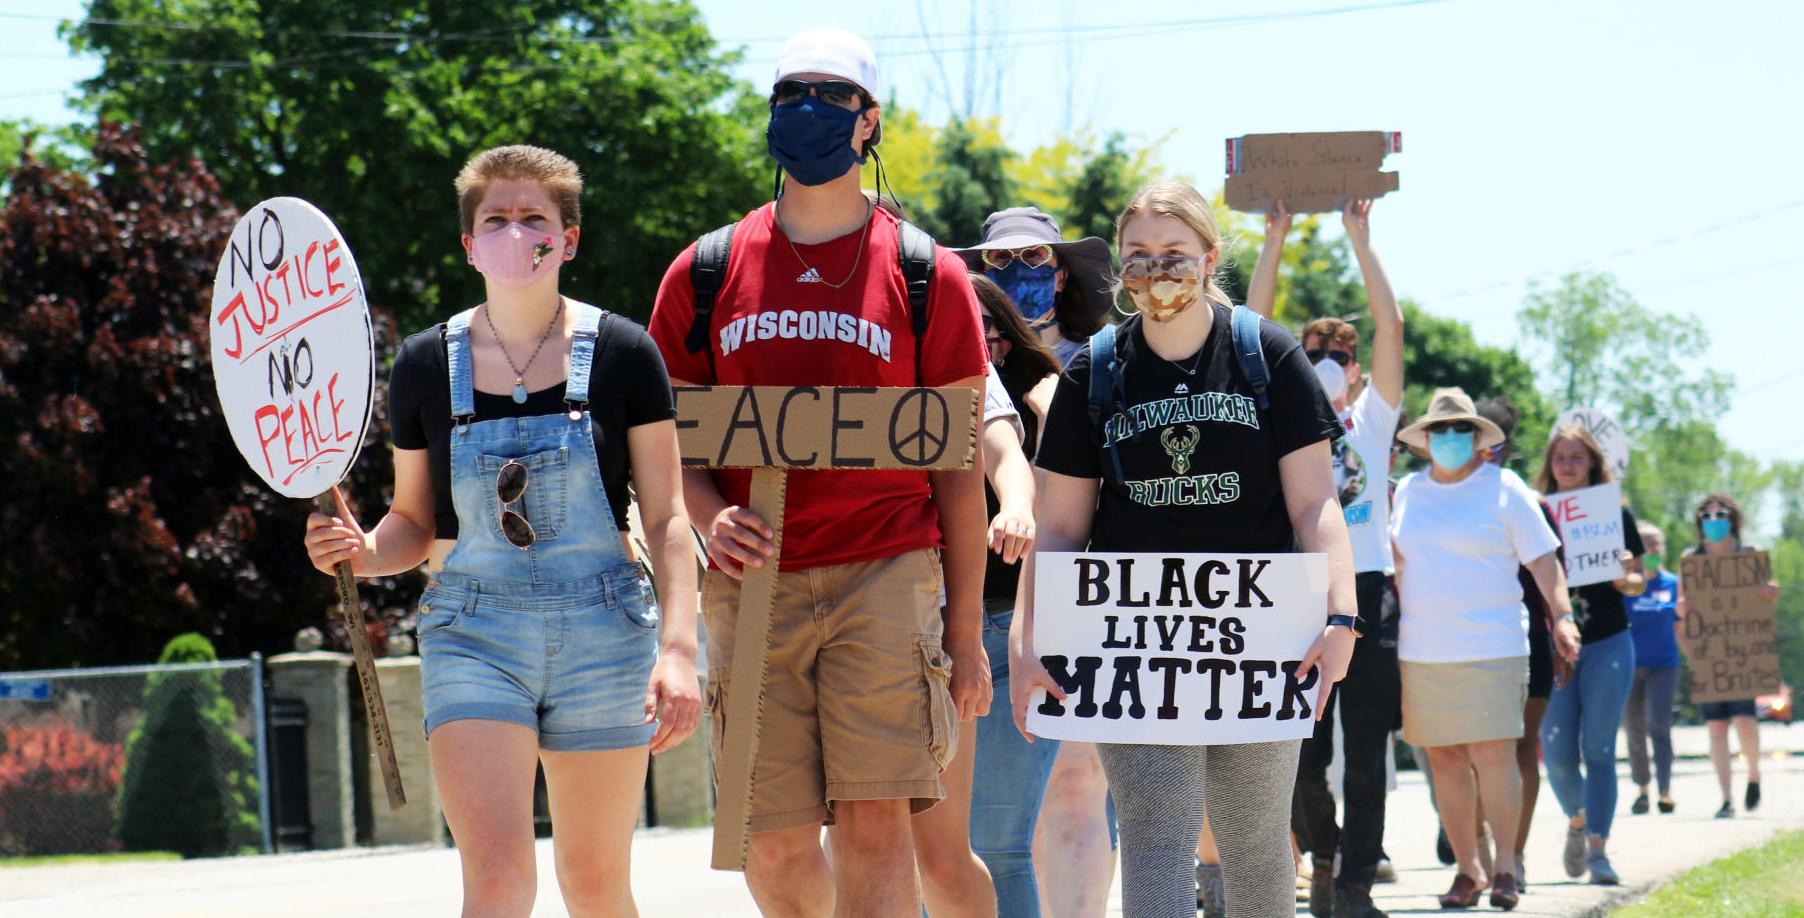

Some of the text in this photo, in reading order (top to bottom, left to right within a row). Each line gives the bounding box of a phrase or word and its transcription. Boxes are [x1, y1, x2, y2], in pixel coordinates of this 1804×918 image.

[231, 208, 284, 288] NO
[217, 239, 345, 359] JUSTICE
[720, 310, 892, 363] WISCONSIN
[268, 337, 313, 399] NO
[254, 372, 353, 478] PEACE
[672, 386, 879, 468] EACE
[1103, 392, 1260, 448] MILWAUKEE
[1569, 412, 1618, 445] OVE
[1126, 471, 1240, 506] BUCKS
[1548, 496, 1588, 523] VE
[1074, 558, 1274, 609] BLACK
[1681, 556, 1772, 592] RACISM
[1101, 615, 1246, 655] LIVES
[1685, 611, 1772, 639] Doctrine
[1037, 655, 1319, 721] MATTER
[1712, 660, 1781, 692] Brutes
